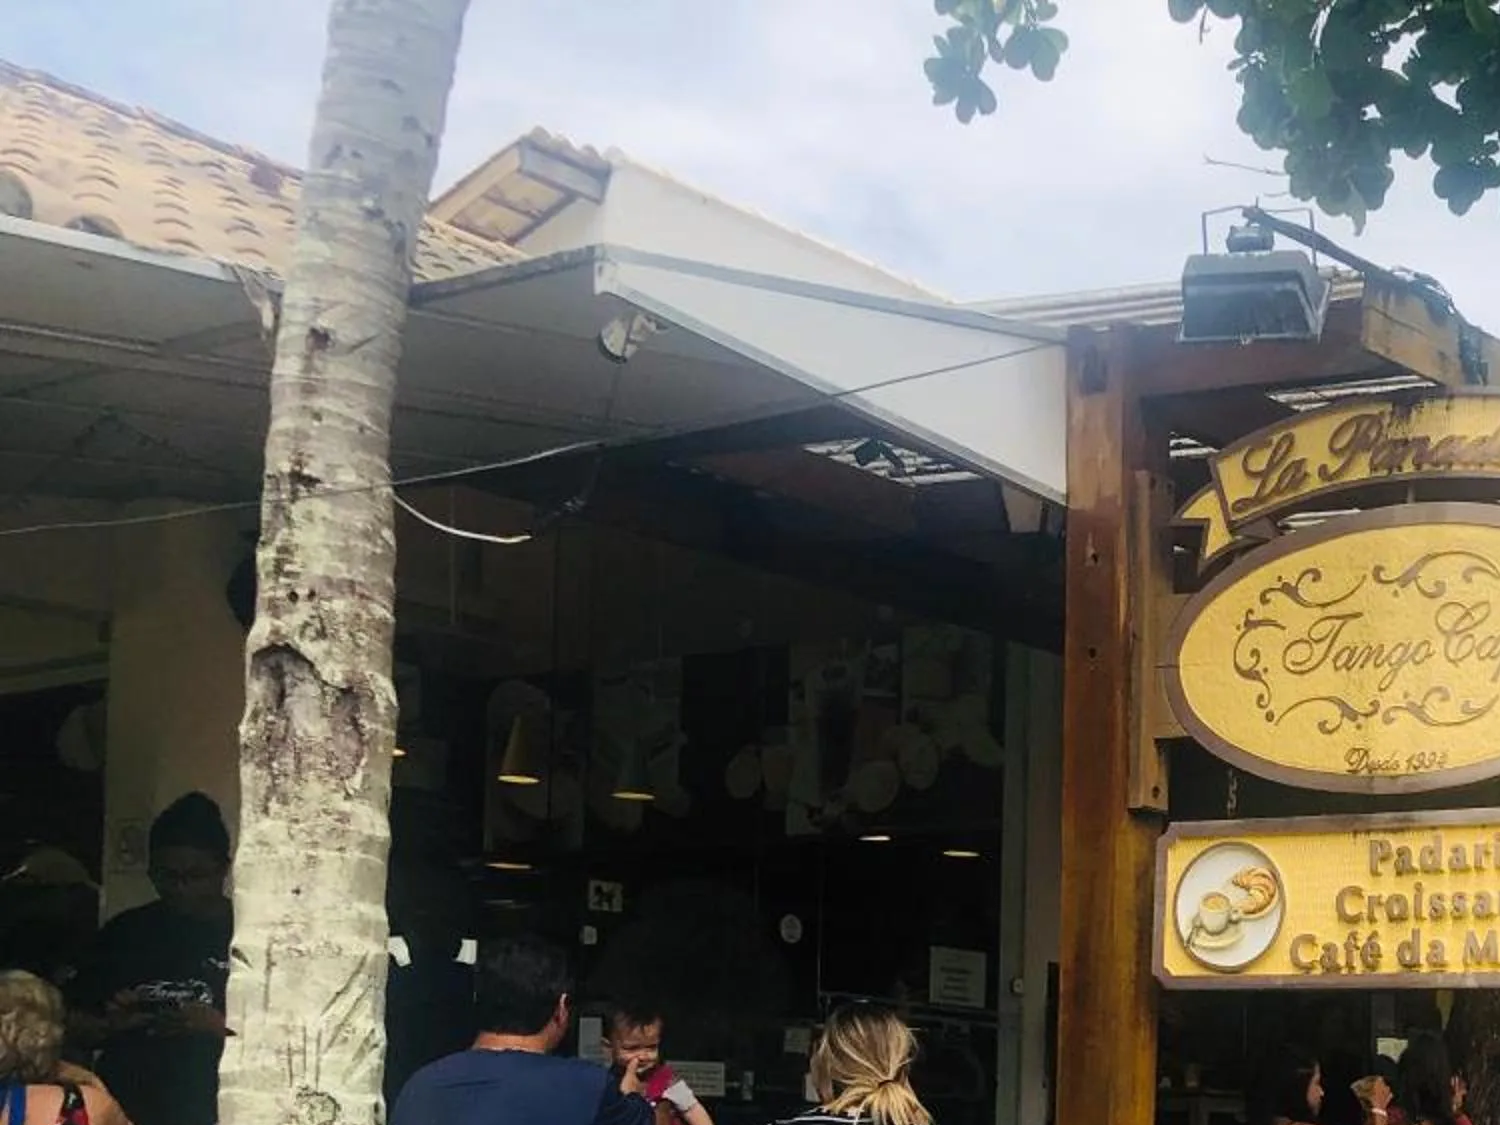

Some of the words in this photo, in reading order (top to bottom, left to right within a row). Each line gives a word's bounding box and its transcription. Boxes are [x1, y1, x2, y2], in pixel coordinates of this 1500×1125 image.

[1233, 430, 1311, 514] La
[1282, 611, 1435, 691] Tango
[1289, 930, 1383, 971] Café
[1395, 928, 1448, 969] da
